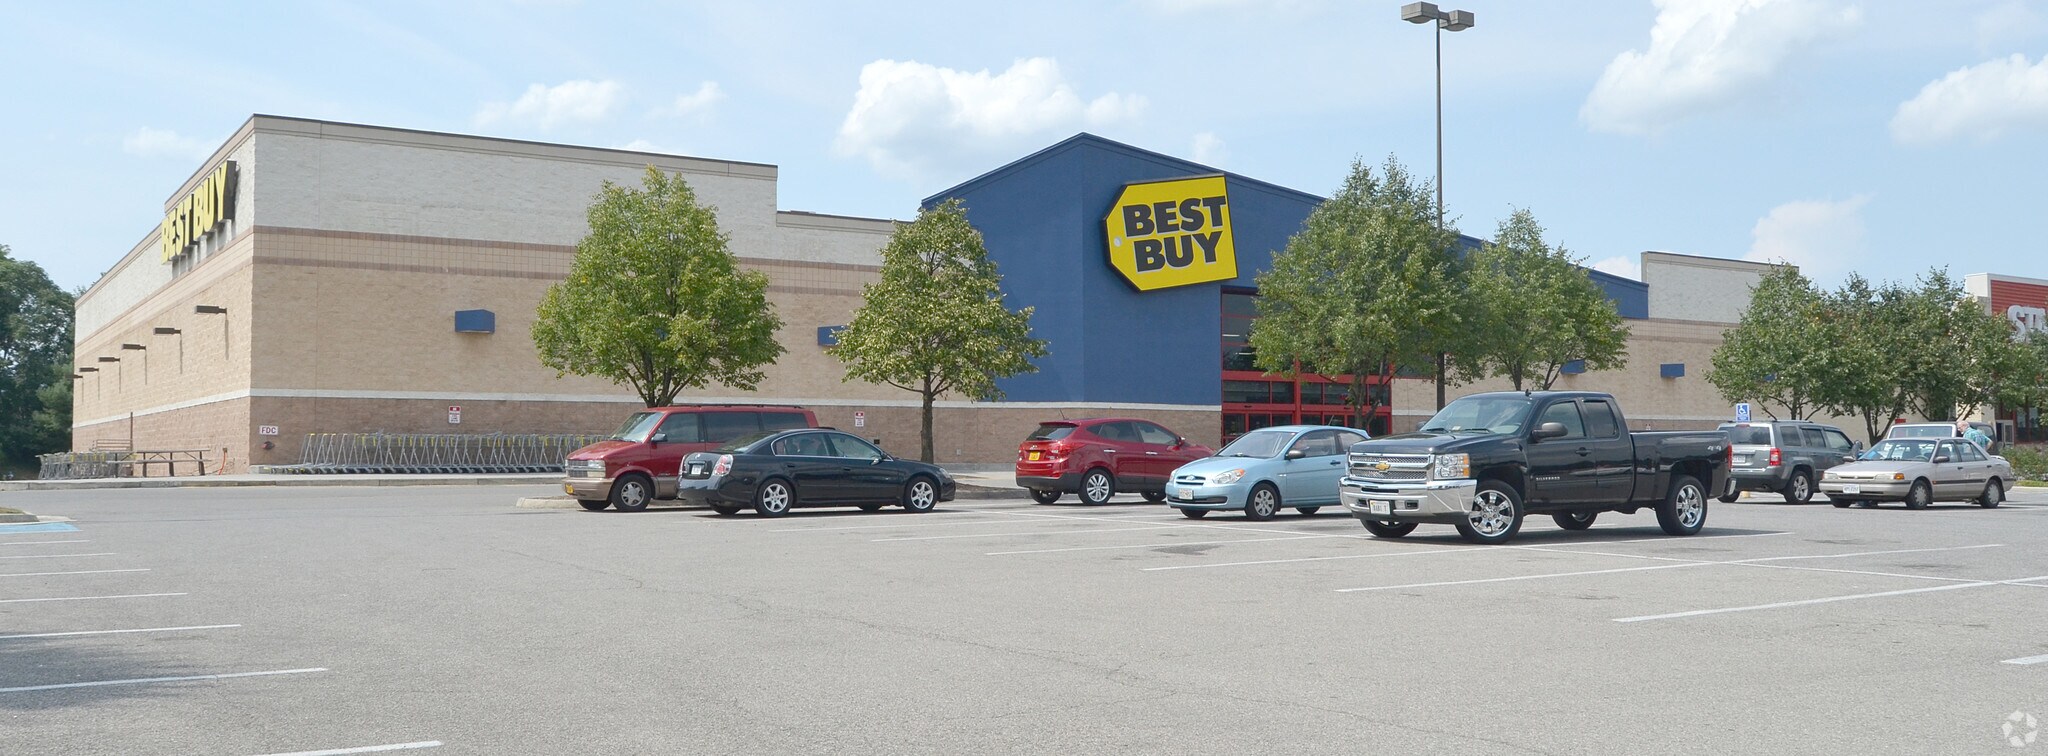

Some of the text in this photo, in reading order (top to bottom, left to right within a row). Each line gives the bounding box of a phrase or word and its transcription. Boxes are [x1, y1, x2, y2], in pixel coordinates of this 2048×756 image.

[161, 160, 229, 265] BEST BUY
[1122, 195, 1226, 237] BEST
[1133, 231, 1223, 272] BUY
[2007, 304, 2048, 344] ST
[261, 426, 277, 434] FDC
